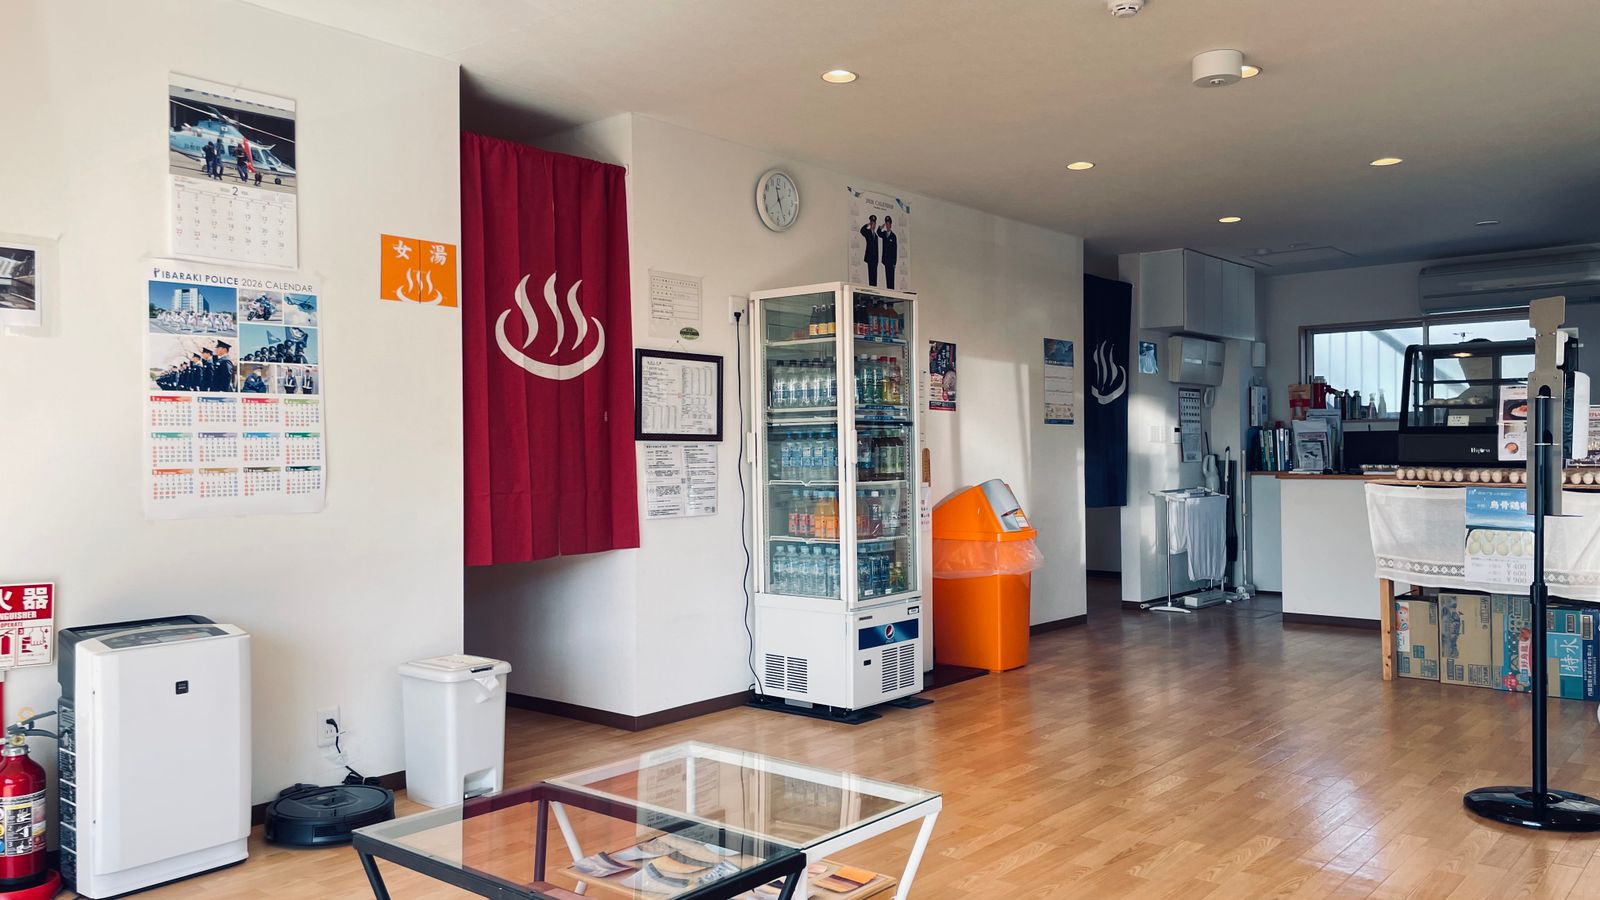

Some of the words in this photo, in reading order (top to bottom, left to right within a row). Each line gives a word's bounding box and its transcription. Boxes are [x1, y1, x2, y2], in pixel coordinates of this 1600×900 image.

[232, 186, 238, 196] 2
[162, 270, 201, 282] IBARAKI
[205, 274, 238, 286] POLICE
[241, 278, 262, 288] 2026
[265, 280, 313, 292] CALENDAR
[1560, 638, 1579, 672] 特水
